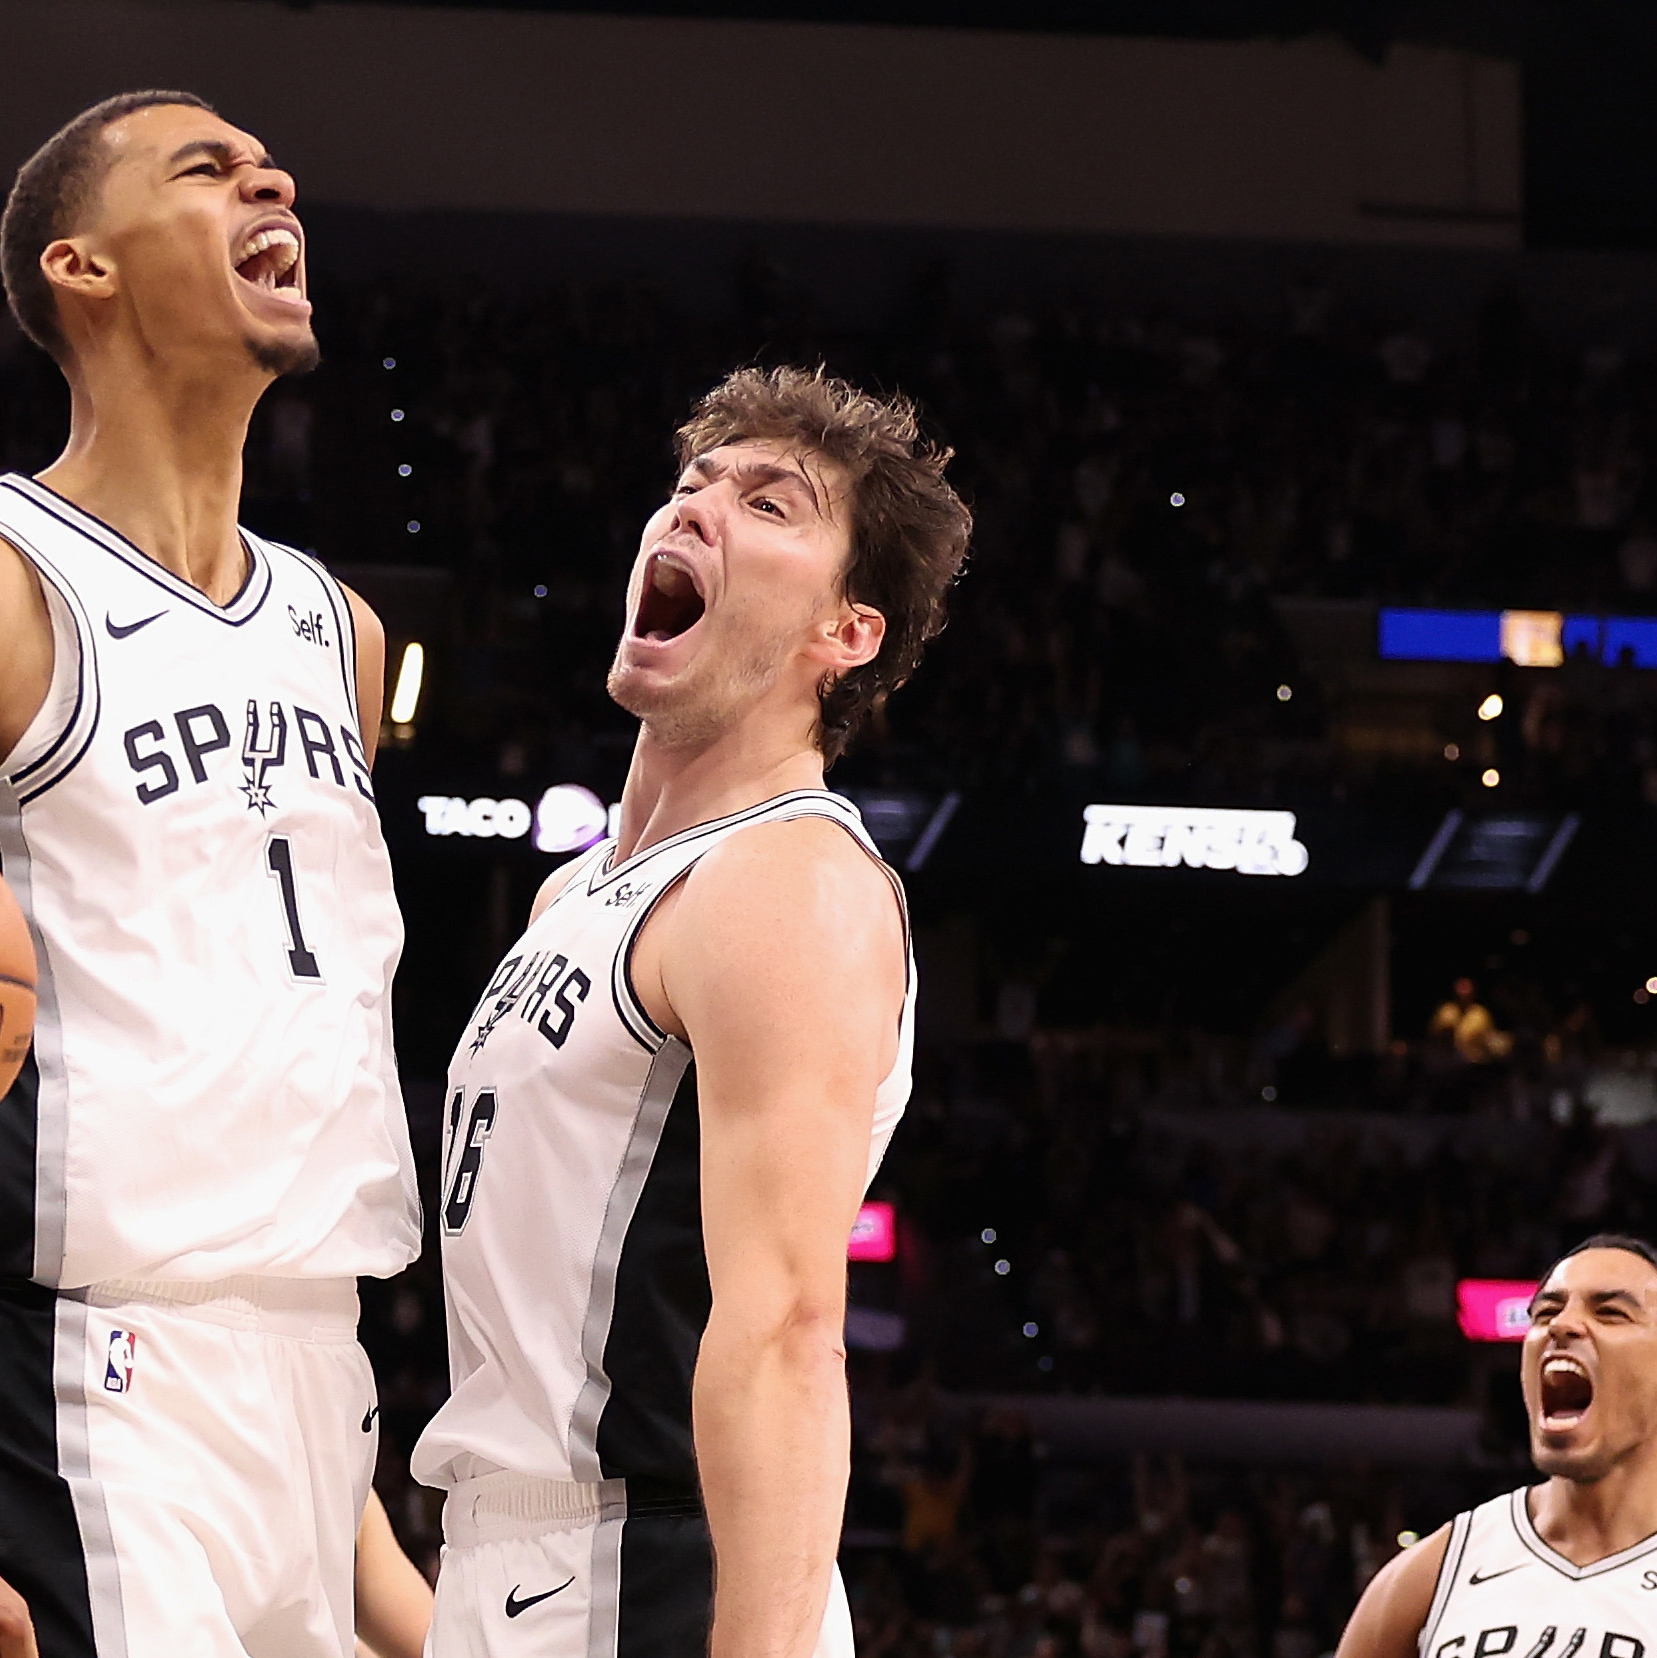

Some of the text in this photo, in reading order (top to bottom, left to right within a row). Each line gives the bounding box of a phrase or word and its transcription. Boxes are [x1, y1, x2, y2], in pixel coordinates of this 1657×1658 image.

[287, 604, 330, 648] Self.
[417, 795, 531, 839] TACO
[264, 831, 327, 986] 1
[441, 1084, 499, 1237] 16
